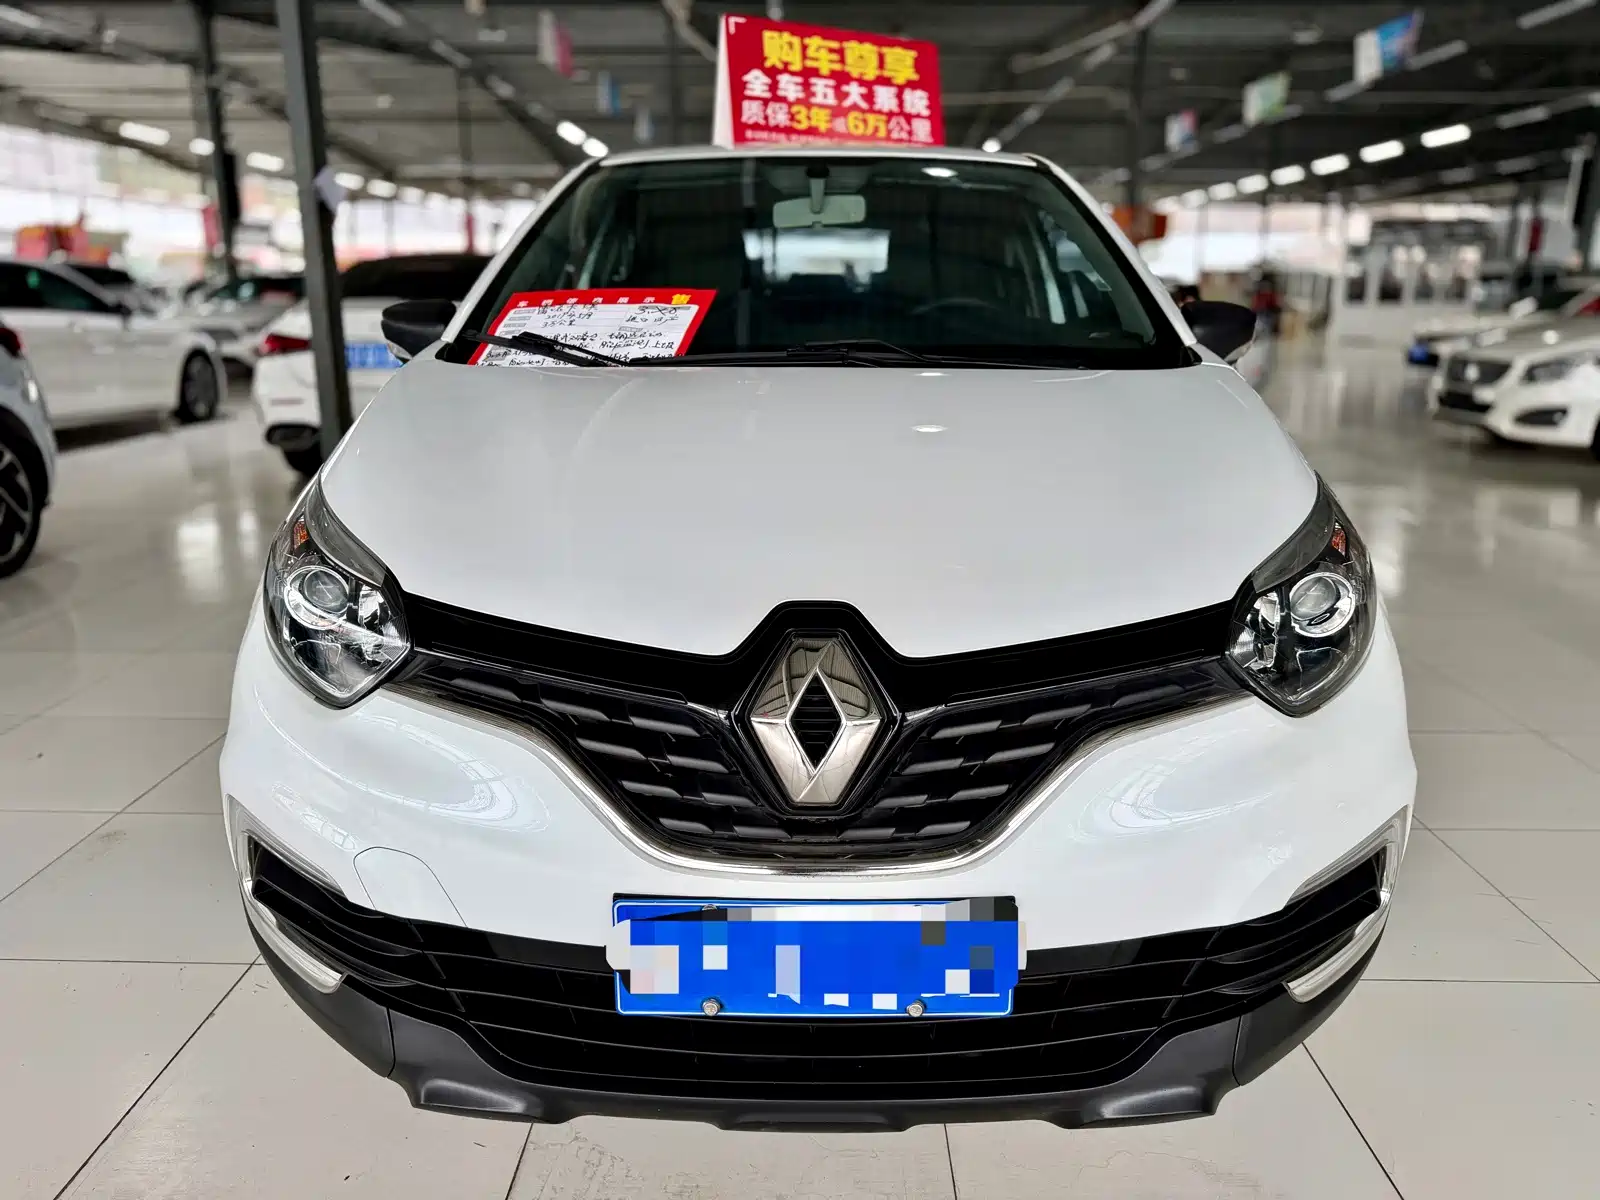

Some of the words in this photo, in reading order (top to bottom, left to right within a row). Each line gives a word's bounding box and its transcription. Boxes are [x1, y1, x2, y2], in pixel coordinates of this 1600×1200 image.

[762, 29, 920, 85] 购车尊享
[741, 68, 931, 116] 全车五大系统
